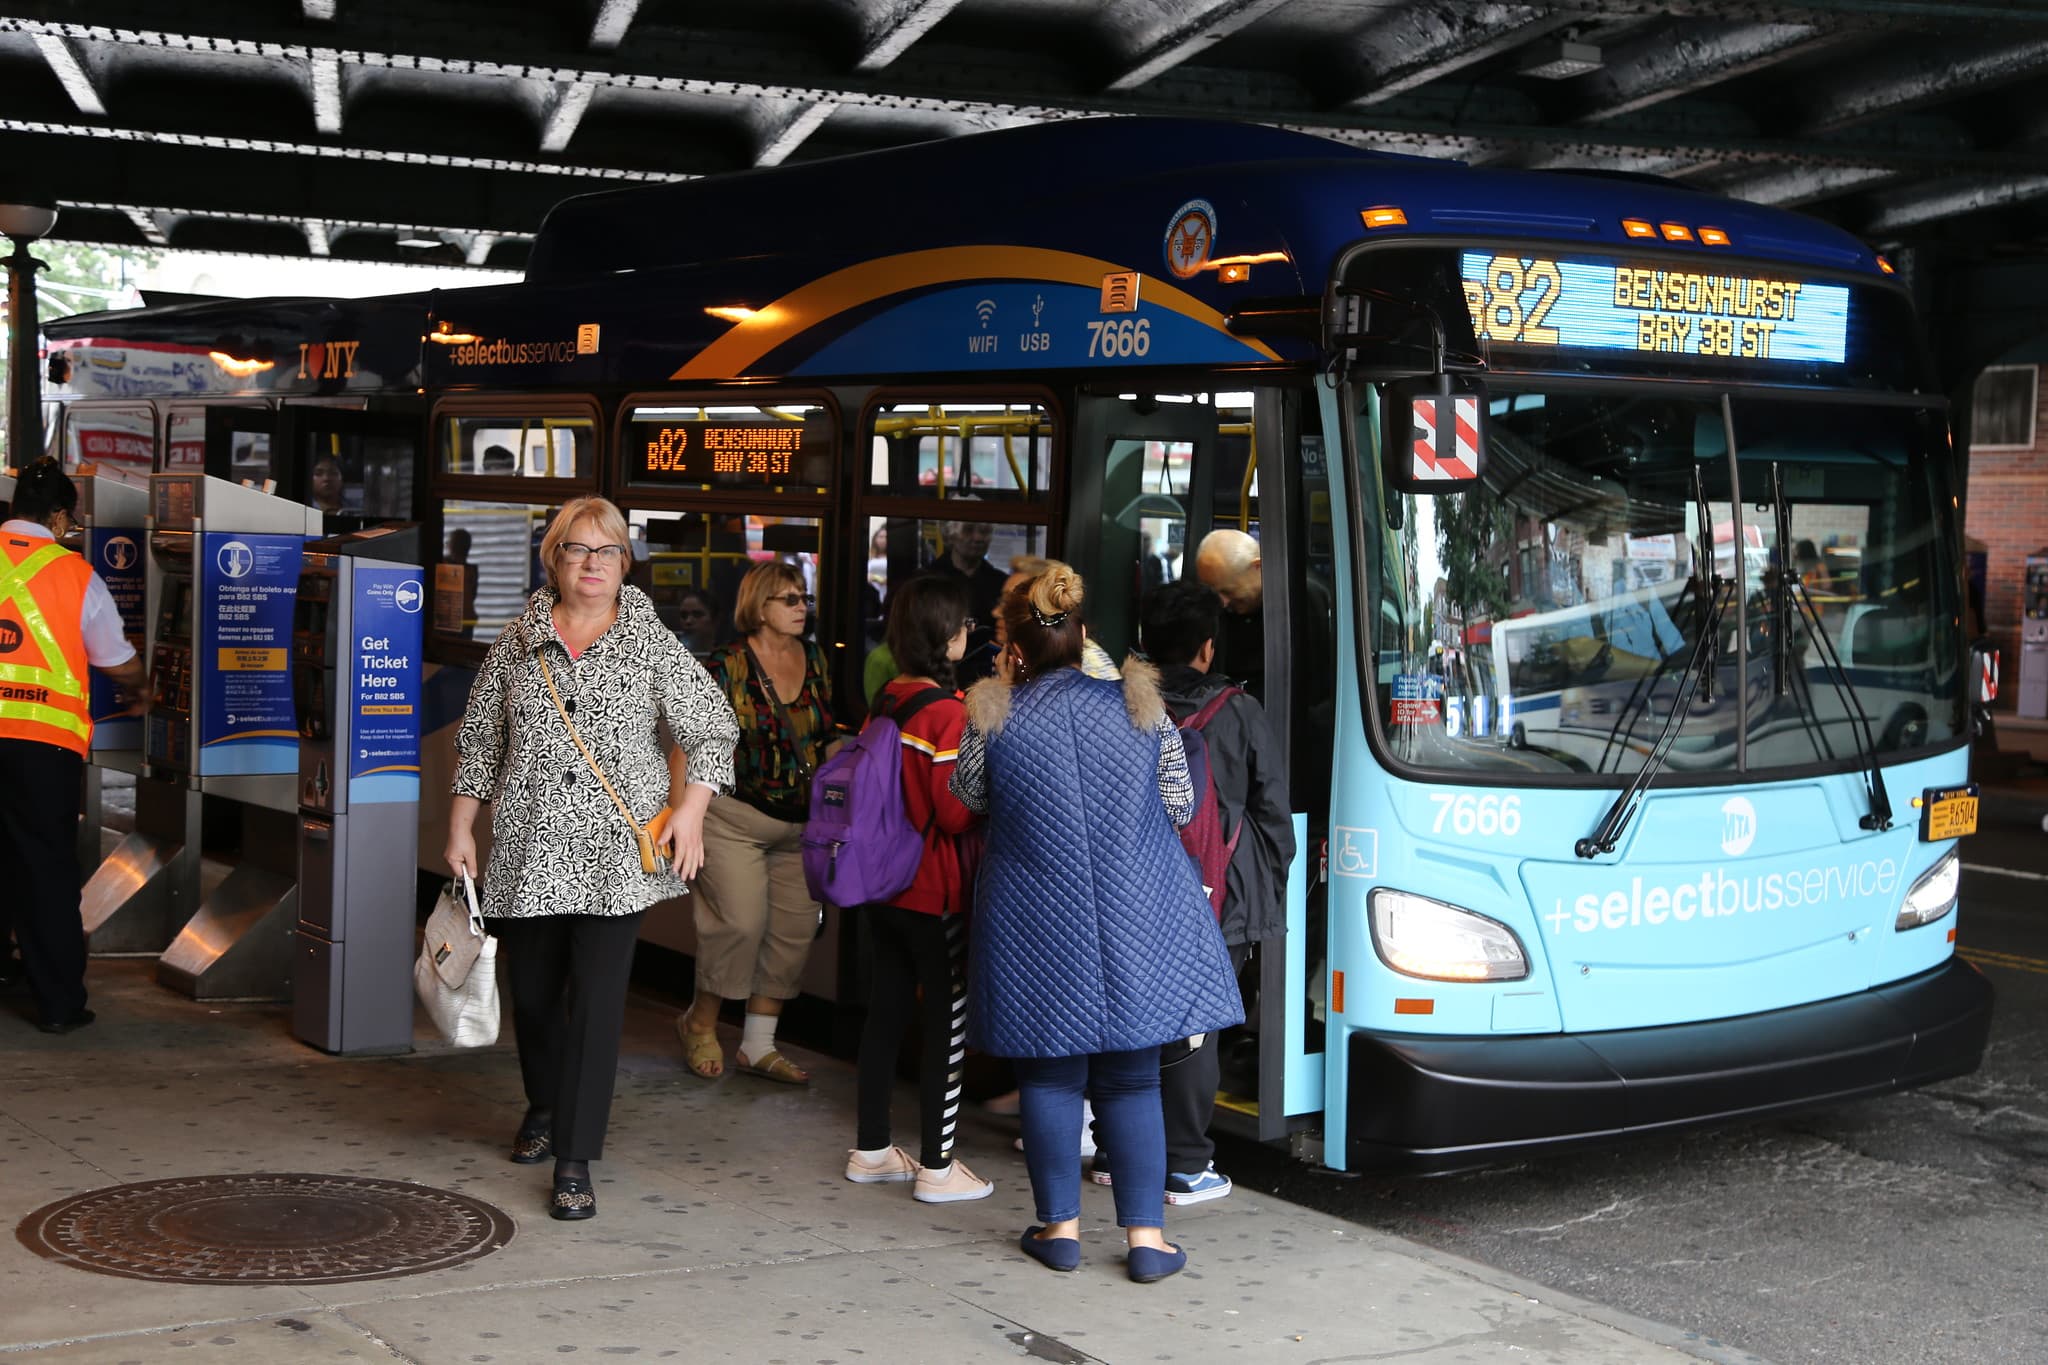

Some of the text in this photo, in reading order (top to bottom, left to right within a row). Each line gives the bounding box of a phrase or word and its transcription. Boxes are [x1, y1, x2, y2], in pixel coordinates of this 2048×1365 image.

[1614, 267, 1801, 320] BENSONHURST
[968, 335, 998, 353] WIFI
[1020, 333, 1050, 351] USB
[1087, 318, 1150, 358] 7666
[1637, 313, 1777, 359] BAY 38 ST
[297, 341, 360, 380] I NY
[647, 428, 688, 471] B82
[714, 452, 792, 473] BAY 38 ST
[219, 585, 250, 593] Obtenga
[361, 636, 390, 650] Get
[361, 655, 409, 669] Ticket
[361, 674, 397, 688] Here
[1429, 793, 1521, 836] 7666
